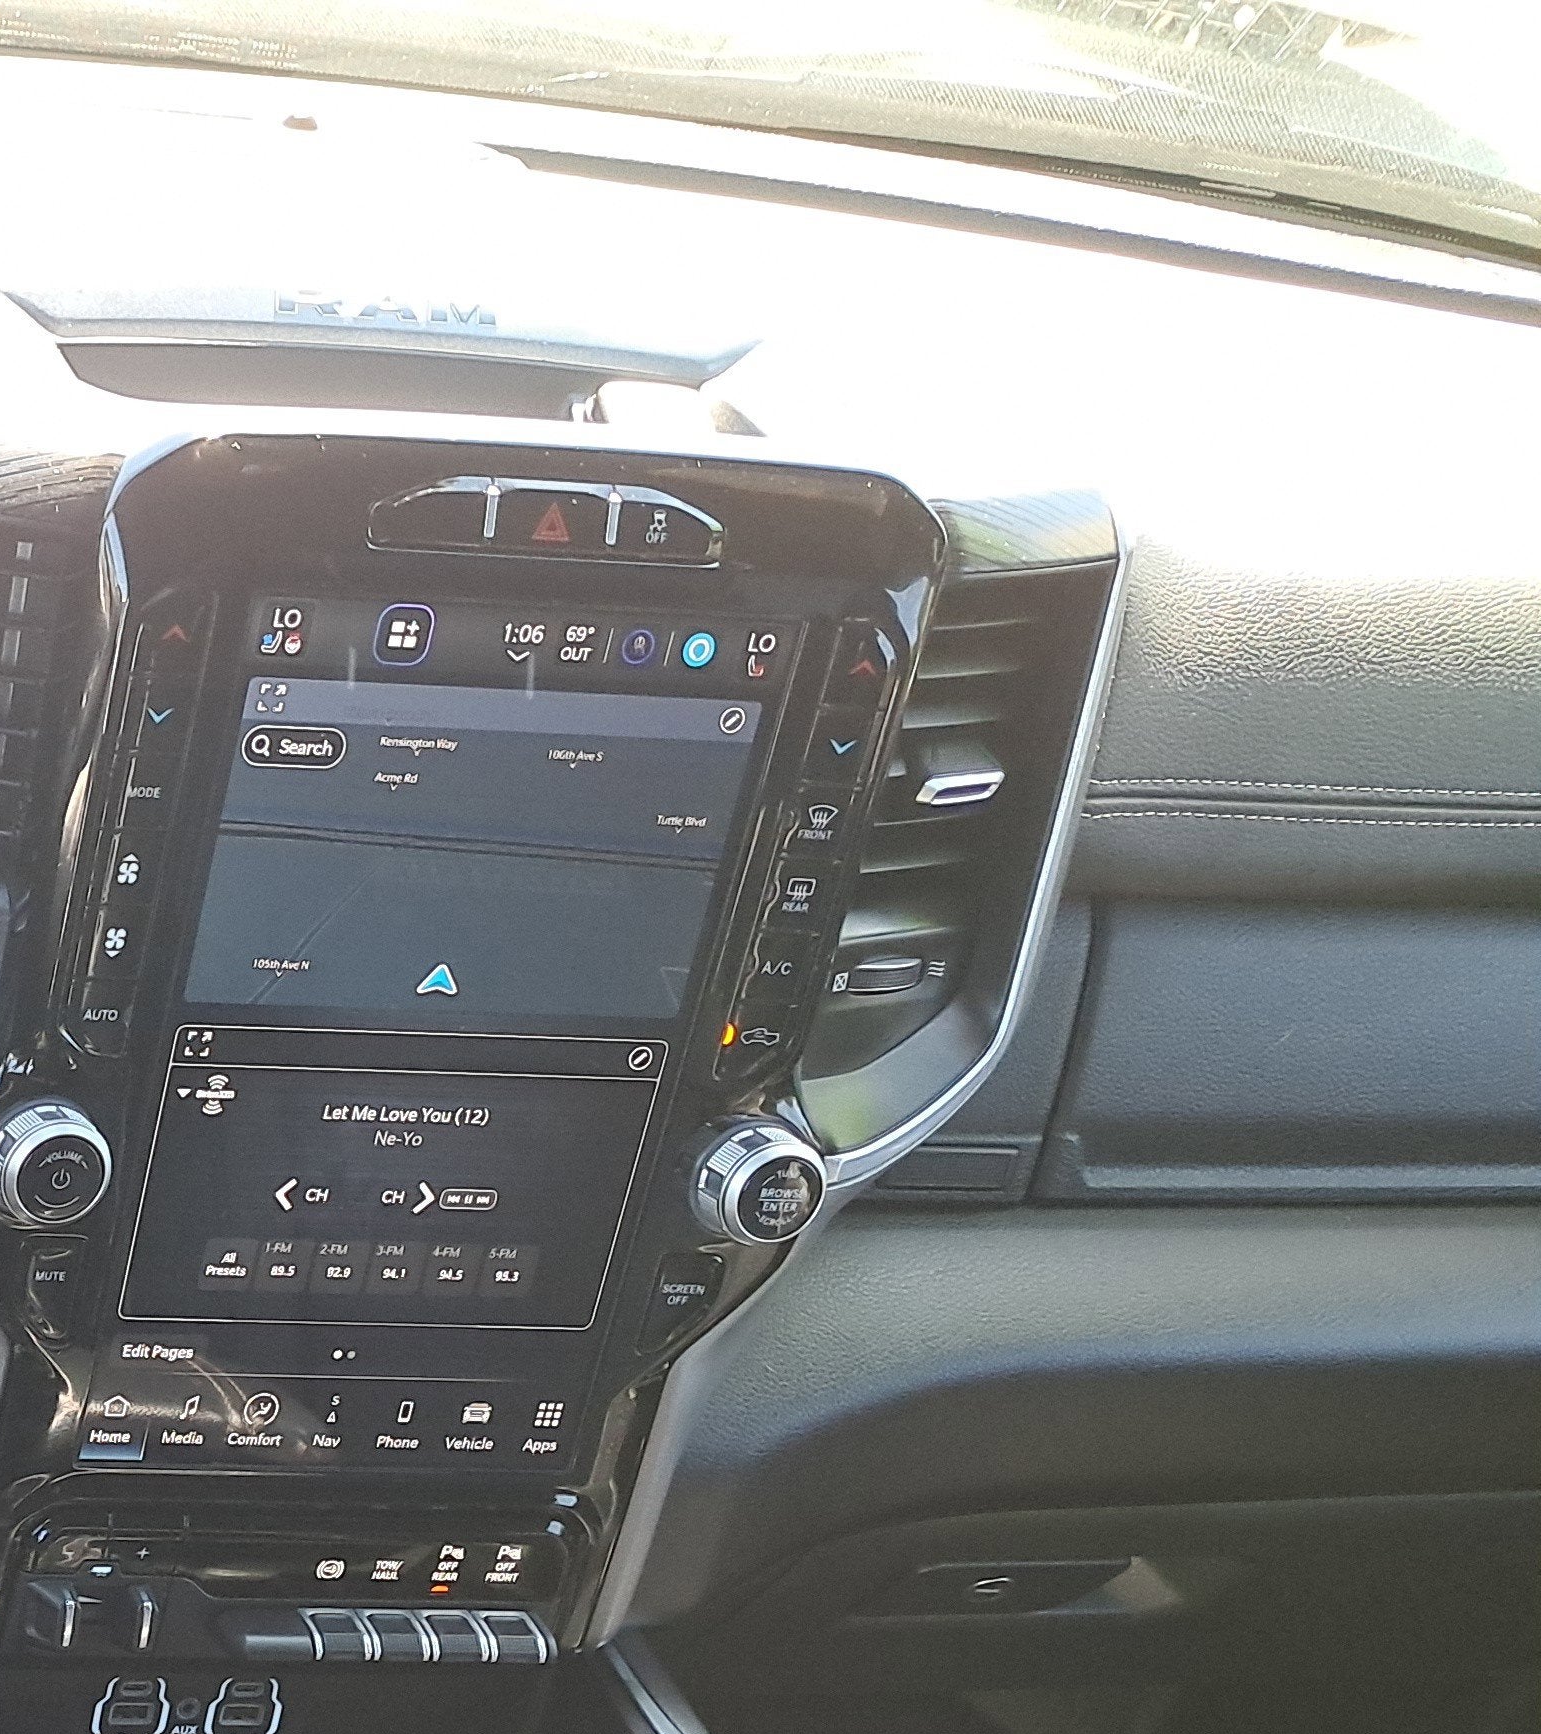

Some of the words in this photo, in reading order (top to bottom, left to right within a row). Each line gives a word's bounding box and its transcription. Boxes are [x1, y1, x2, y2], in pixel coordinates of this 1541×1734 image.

[645, 532, 668, 544] OFF
[272, 608, 303, 629] LO
[502, 623, 545, 645] 1:06
[565, 624, 597, 645] 69°
[747, 633, 777, 654] LO
[560, 646, 594, 663] OUT
[278, 738, 334, 758] Search
[126, 785, 161, 799] MODE
[797, 829, 833, 841] FRONT
[781, 902, 809, 914] REAR
[761, 960, 793, 976] A/C
[83, 1007, 118, 1022] AUTO
[322, 1104, 350, 1121] Let
[351, 1105, 377, 1122] Me
[379, 1106, 418, 1123] Love
[421, 1106, 453, 1125] You
[454, 1107, 490, 1127] (12)
[373, 1129, 423, 1147] Ne-Yo
[305, 1188, 330, 1203] CH
[381, 1190, 406, 1205] CH
[762, 1201, 798, 1213] ENTER
[35, 1270, 66, 1282] MUTE
[205, 1264, 246, 1277] Presets
[662, 1284, 706, 1296] SCREEN
[667, 1295, 689, 1306] OFF
[122, 1344, 149, 1359] Edit
[151, 1345, 194, 1362] Pages
[89, 1429, 131, 1444] Home
[161, 1430, 204, 1446] Media
[227, 1431, 283, 1448] Comfort
[313, 1434, 341, 1448] Nav
[376, 1435, 419, 1450] Phone
[445, 1436, 494, 1451] Vehicle
[522, 1438, 558, 1455] Apps
[437, 1561, 459, 1571] OFF
[494, 1562, 517, 1572] OFF
[431, 1572, 459, 1582] REAR
[484, 1572, 519, 1583] FRONT
